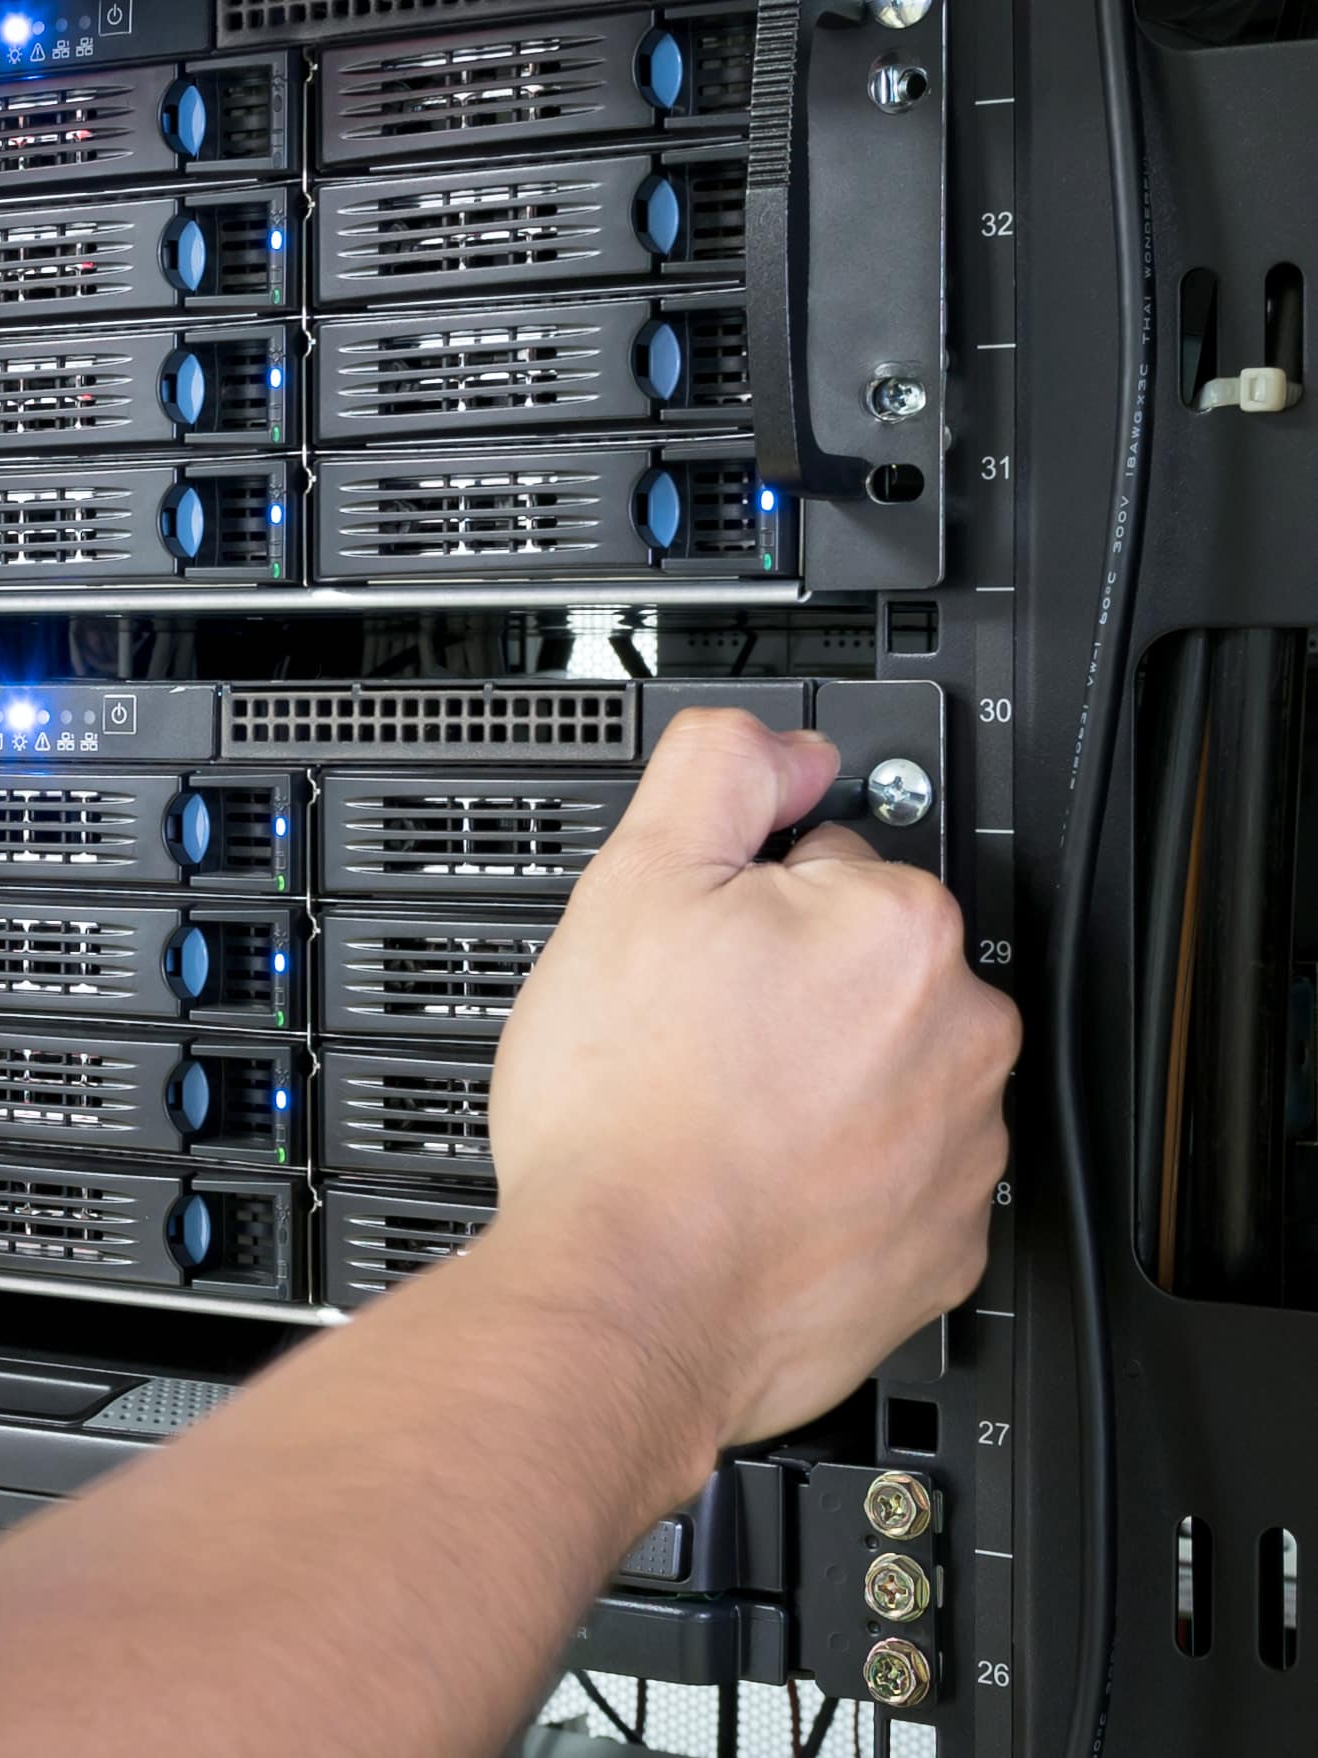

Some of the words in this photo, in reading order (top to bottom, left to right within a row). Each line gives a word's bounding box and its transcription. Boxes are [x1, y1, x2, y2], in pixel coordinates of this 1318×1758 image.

[981, 211, 1013, 237] 32
[1112, 495, 1130, 553] 300V
[1141, 296, 1151, 345] THAI
[981, 455, 1011, 480] 31
[979, 698, 1012, 723] 30
[979, 940, 1012, 964] 29
[991, 1181, 1012, 1206] 8
[978, 1420, 1010, 1446] 27
[977, 1660, 1010, 1687] 26
